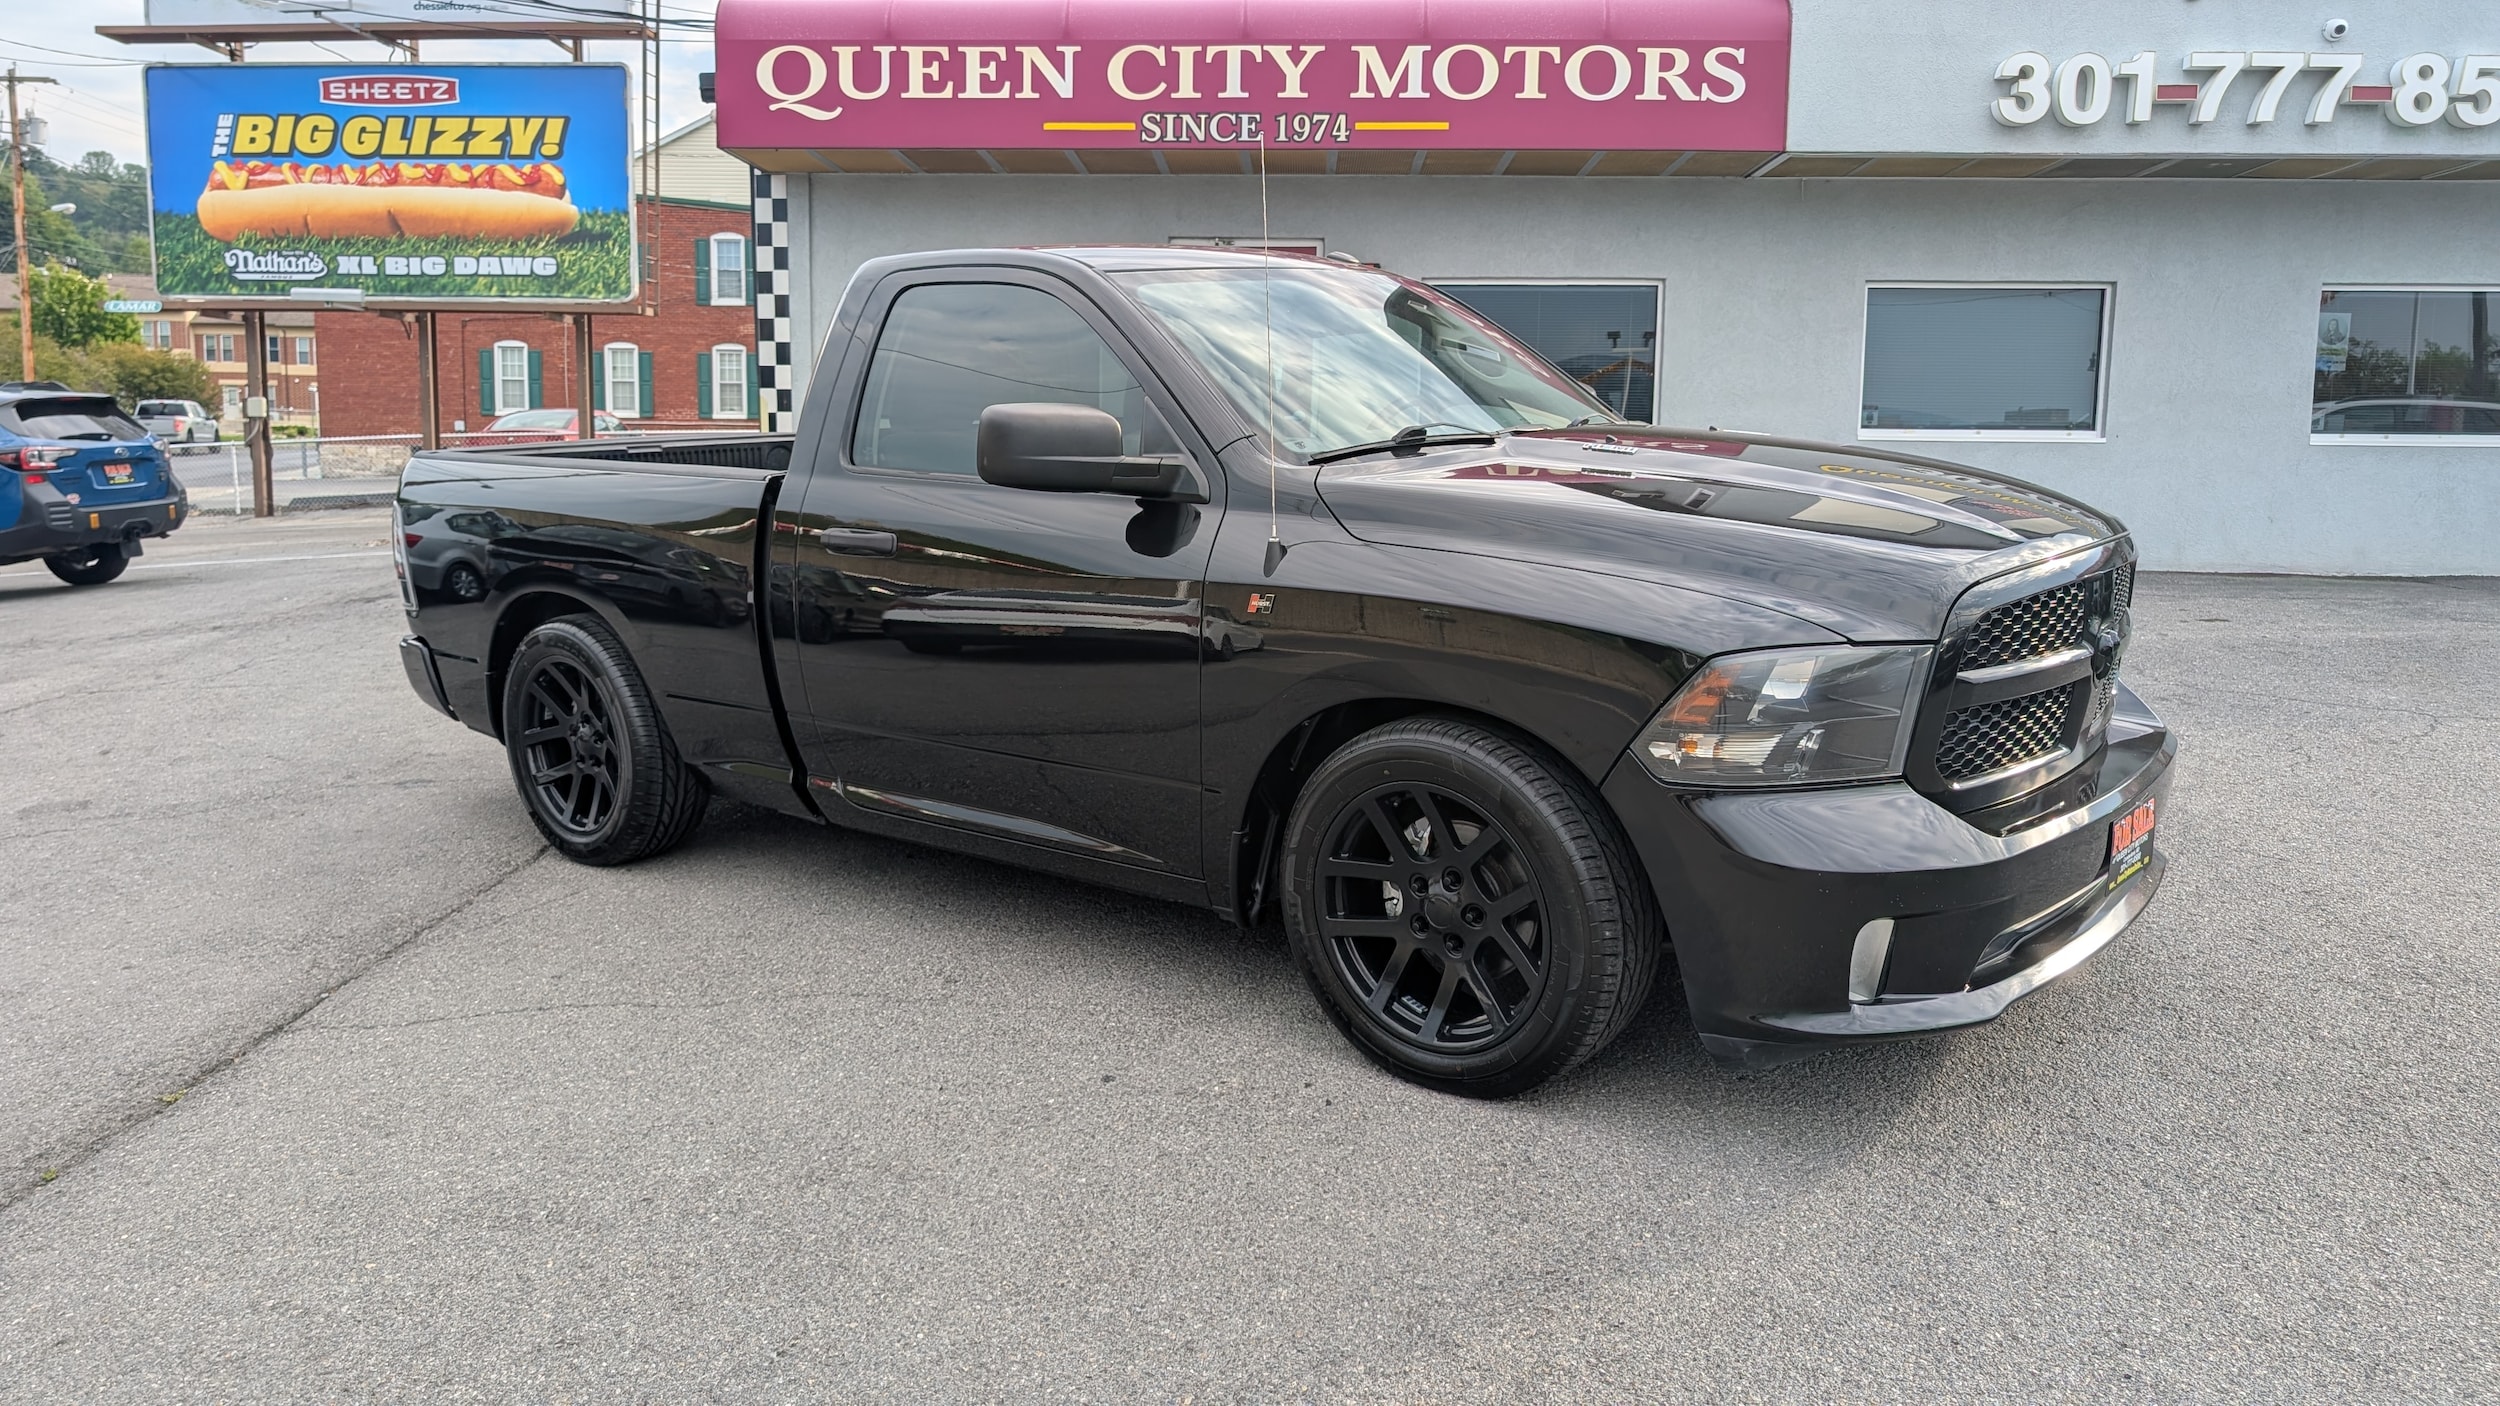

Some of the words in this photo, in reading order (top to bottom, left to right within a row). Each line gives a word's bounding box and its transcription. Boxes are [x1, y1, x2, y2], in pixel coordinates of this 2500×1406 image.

[328, 82, 450, 100] SHEETZ
[755, 44, 1082, 121] QUEEN
[1106, 44, 1326, 101] CITY
[1350, 44, 1747, 104] MOTORS
[1991, 50, 2500, 128] 301-777-85
[211, 113, 235, 158] THE
[231, 113, 338, 157] BIG
[340, 115, 569, 159] GLIZZY!
[1140, 112, 1262, 143] SINCE
[1274, 112, 1352, 143] 1974
[224, 249, 328, 274] Nathan's
[336, 255, 379, 275] XL
[384, 256, 448, 276] BIG
[453, 256, 558, 276] DAWG
[108, 301, 157, 311] LAMAR
